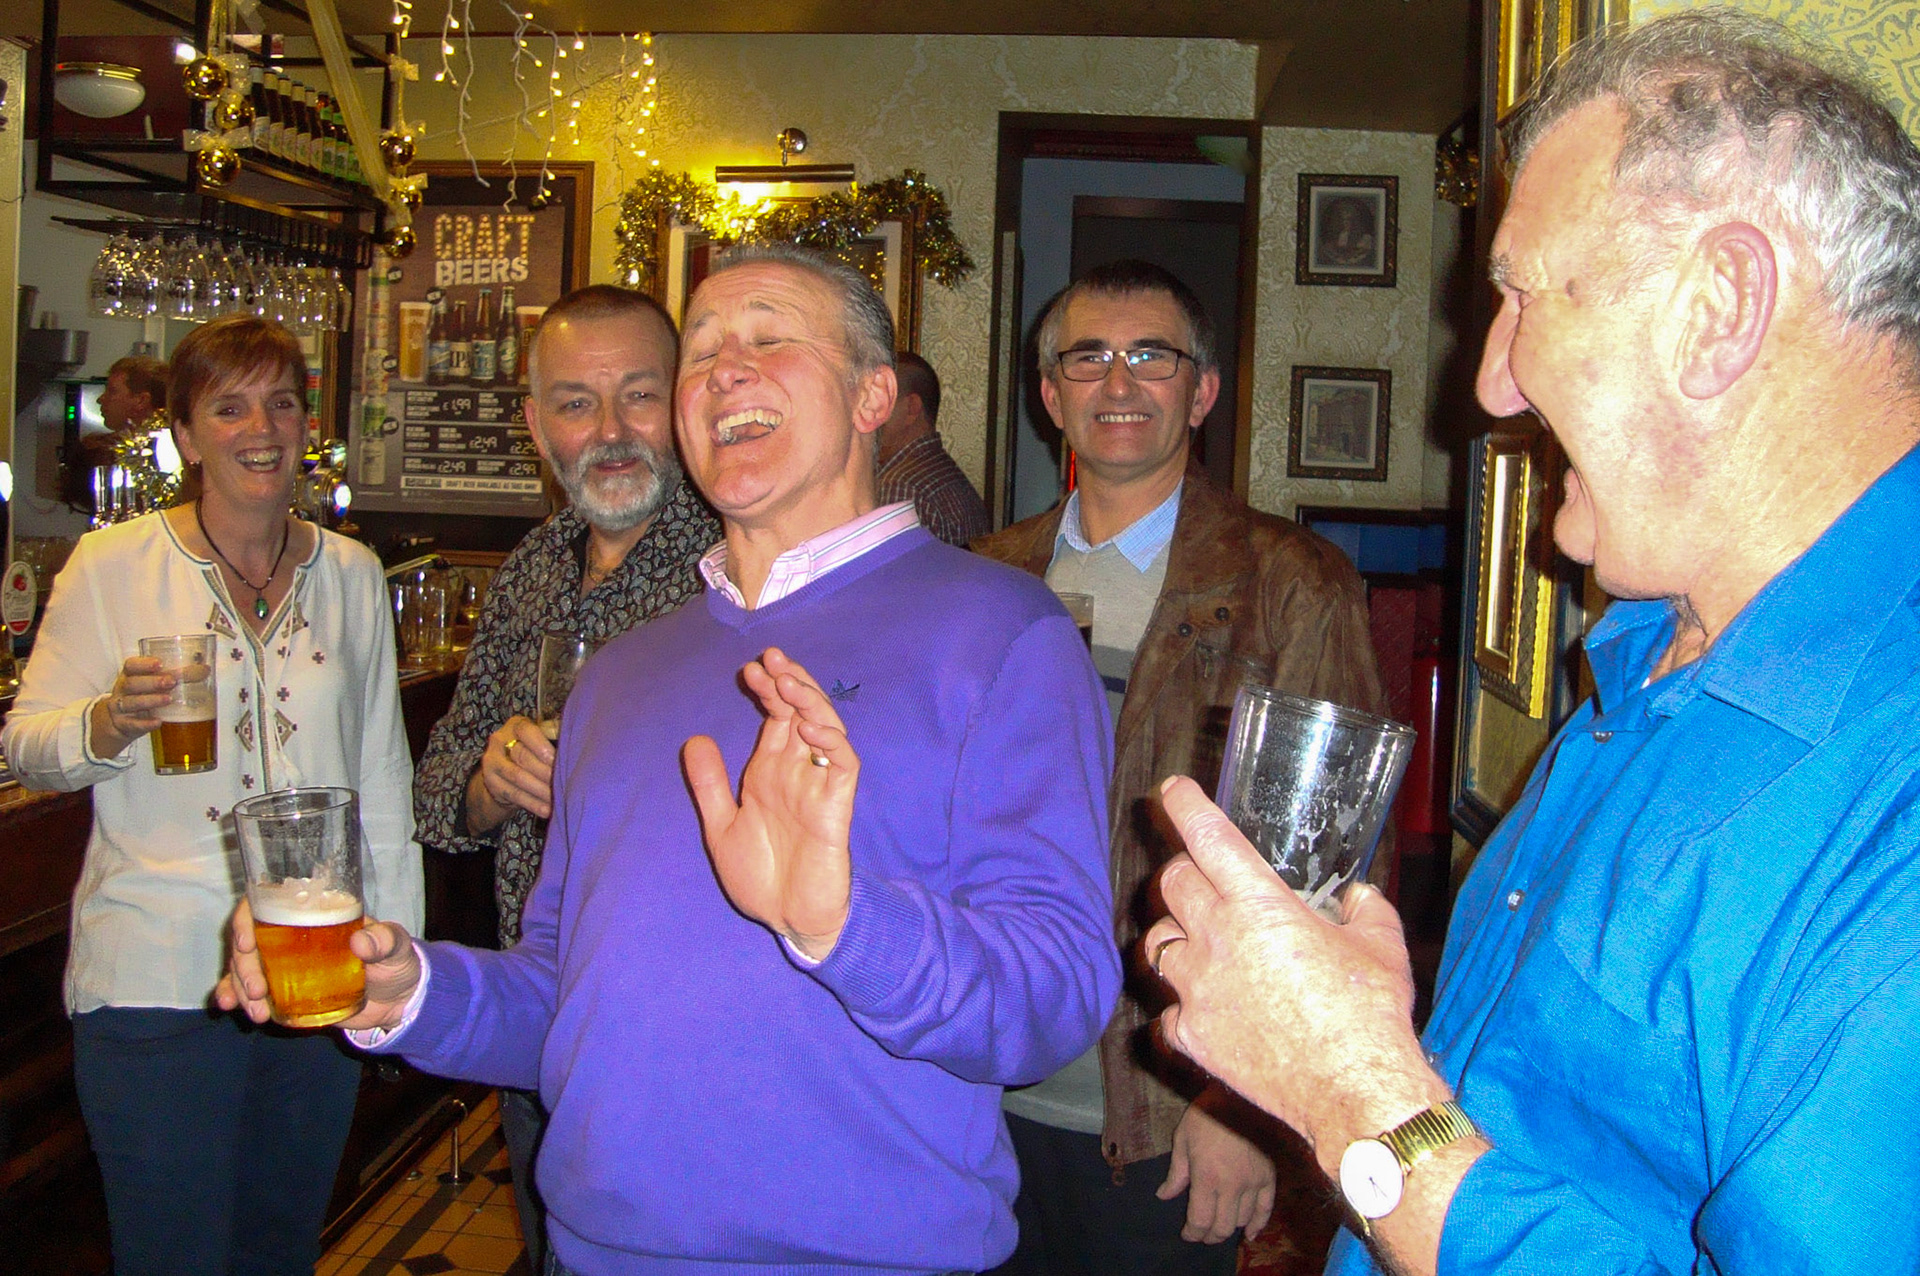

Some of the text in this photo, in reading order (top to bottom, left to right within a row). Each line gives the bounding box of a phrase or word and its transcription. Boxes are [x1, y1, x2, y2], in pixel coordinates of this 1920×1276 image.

[435, 214, 536, 259] CRAFT
[435, 257, 529, 286] BEERS
[469, 436, 498, 449] £2.49
[438, 461, 466, 474] £2.49
[509, 463, 537, 476] £2.99
